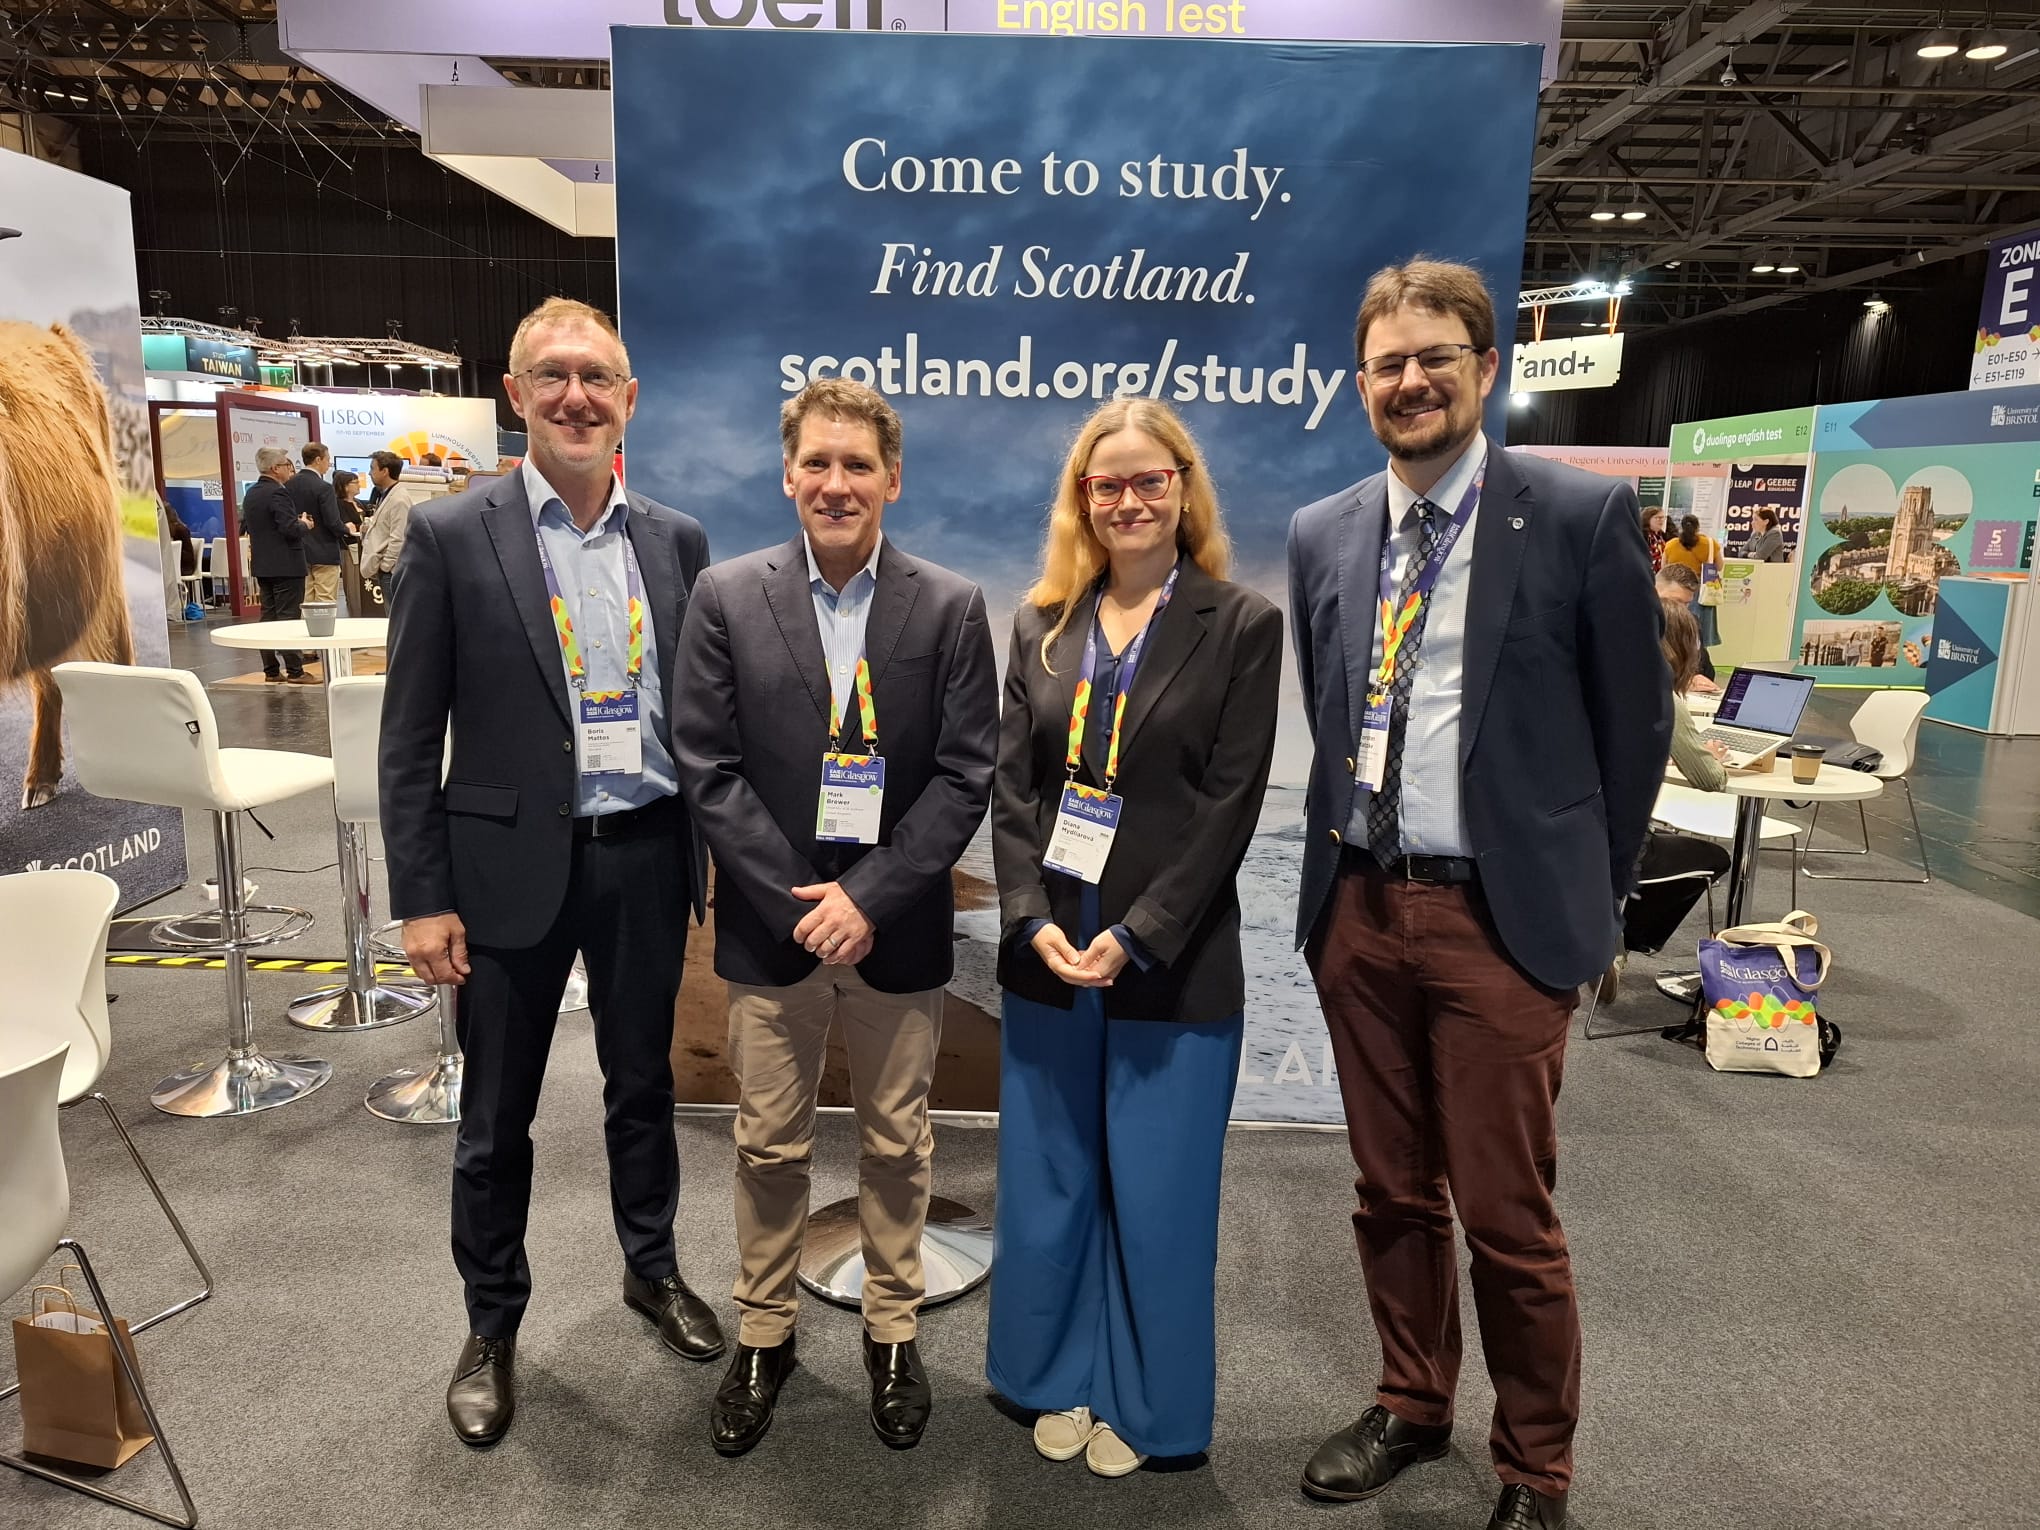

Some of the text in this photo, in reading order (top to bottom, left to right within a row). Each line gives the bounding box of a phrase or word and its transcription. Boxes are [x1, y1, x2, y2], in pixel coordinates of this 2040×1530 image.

[997, 0, 1146, 36] English
[842, 136, 1292, 221] Come to study.
[870, 242, 1256, 304] Find Scotland.
[2000, 267, 2034, 326] E
[1987, 351, 2027, 366] E01-E50
[202, 357, 242, 377] TAIWAN
[779, 332, 1347, 430] scotland.org/study
[1985, 368, 2025, 383] E51-E119
[322, 409, 385, 426] LISBON
[2006, 414, 2039, 425] BRISTOL
[1795, 425, 1808, 436] E12
[1824, 422, 1837, 433] E11
[1706, 427, 1783, 448] duolingo english test
[431, 432, 485, 472] LUMINOUS PERSPE
[1569, 456, 1605, 467] Regent's
[1607, 456, 1649, 468] University
[1734, 479, 1752, 489] LEAP
[1767, 478, 1797, 487] GEEBEE
[1950, 651, 1980, 665] BRISTOL
[600, 705, 633, 717] Glasgow
[843, 770, 878, 783] Glasgow
[827, 798, 850, 806] Brewer
[1080, 801, 1114, 820] Glasgow
[1063, 819, 1081, 830] Diana
[1735, 967, 1790, 983] Glasgo
